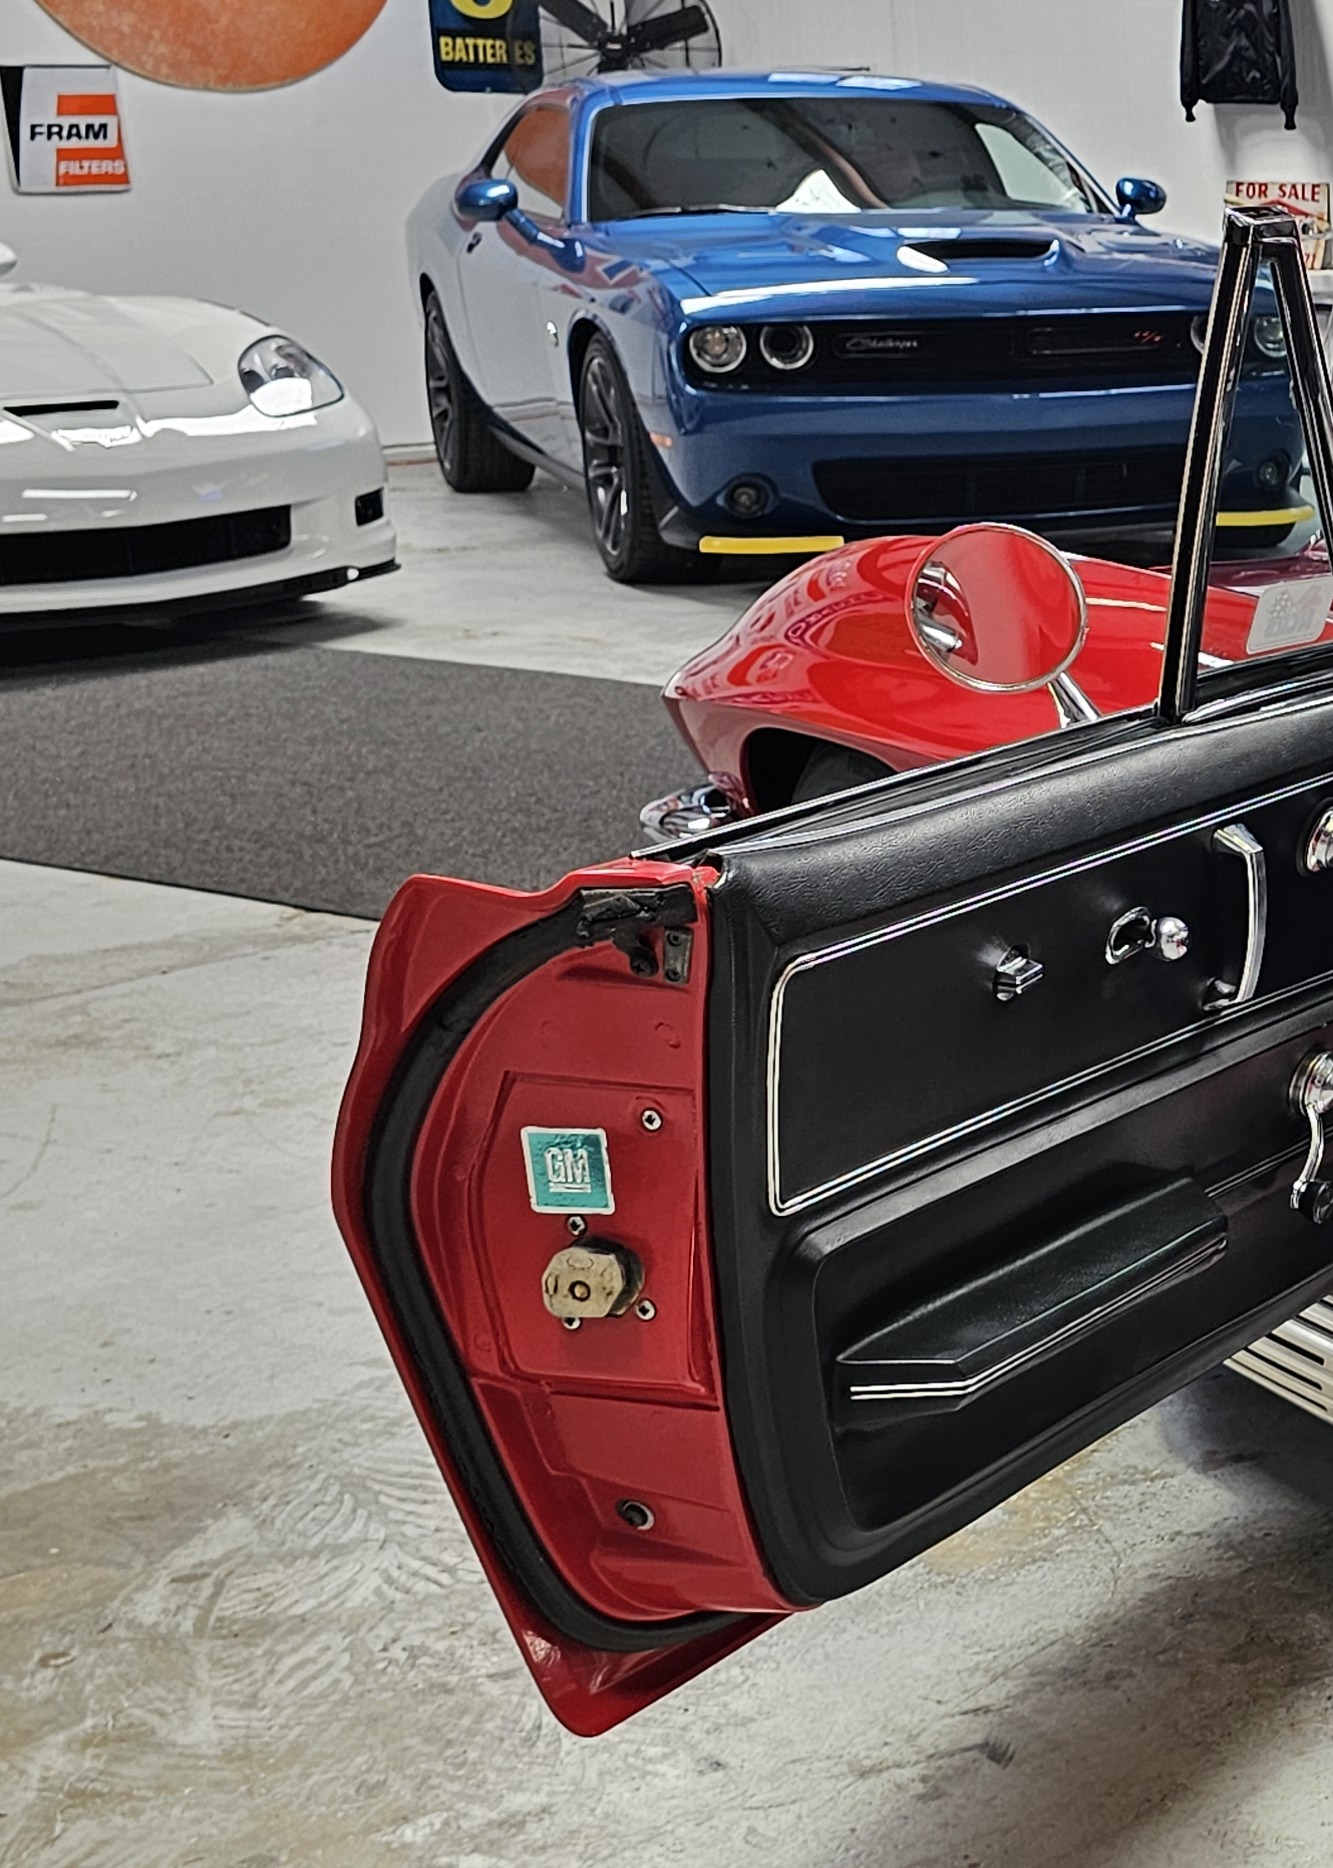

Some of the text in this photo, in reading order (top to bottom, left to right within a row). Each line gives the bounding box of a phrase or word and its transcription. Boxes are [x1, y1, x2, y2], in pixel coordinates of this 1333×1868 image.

[30, 123, 108, 141] FRAM
[58, 160, 126, 176] FILTERS
[1235, 181, 1321, 203] FOR SALE
[544, 1146, 592, 1183] GM
